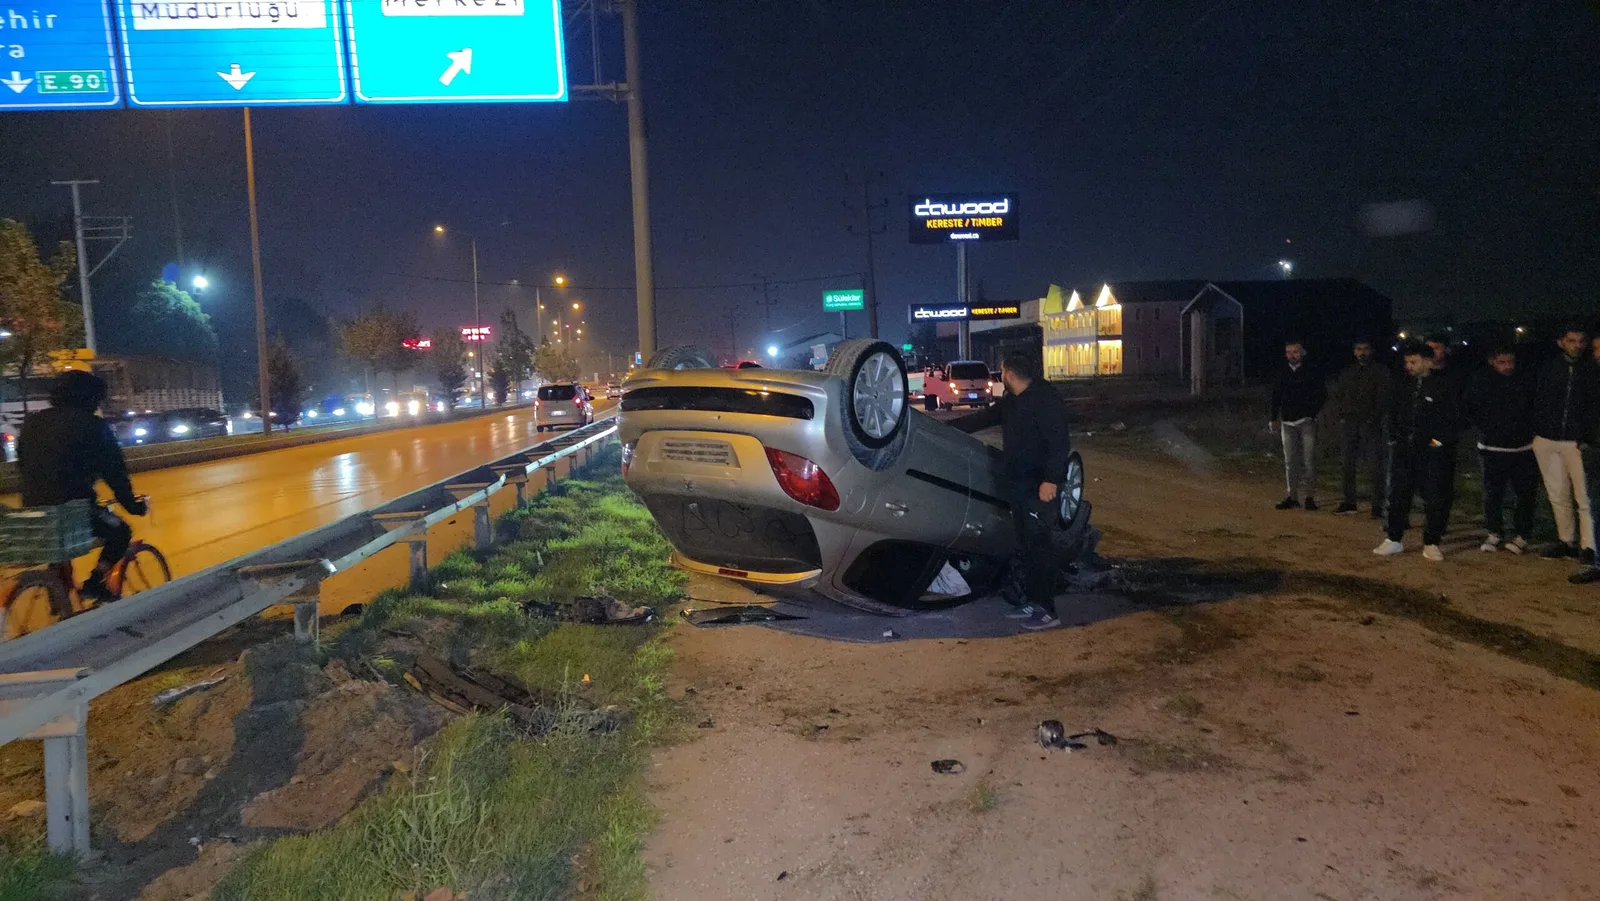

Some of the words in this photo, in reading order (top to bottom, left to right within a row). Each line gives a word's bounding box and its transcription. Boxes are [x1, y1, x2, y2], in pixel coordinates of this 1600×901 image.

[141, 2, 298, 23] Müdürlüğü
[43, 74, 101, 90] E.90
[915, 198, 1008, 216] dawood
[926, 218, 963, 229] KERESTE
[971, 217, 1003, 227] TIMBER
[914, 307, 967, 318] dawood
